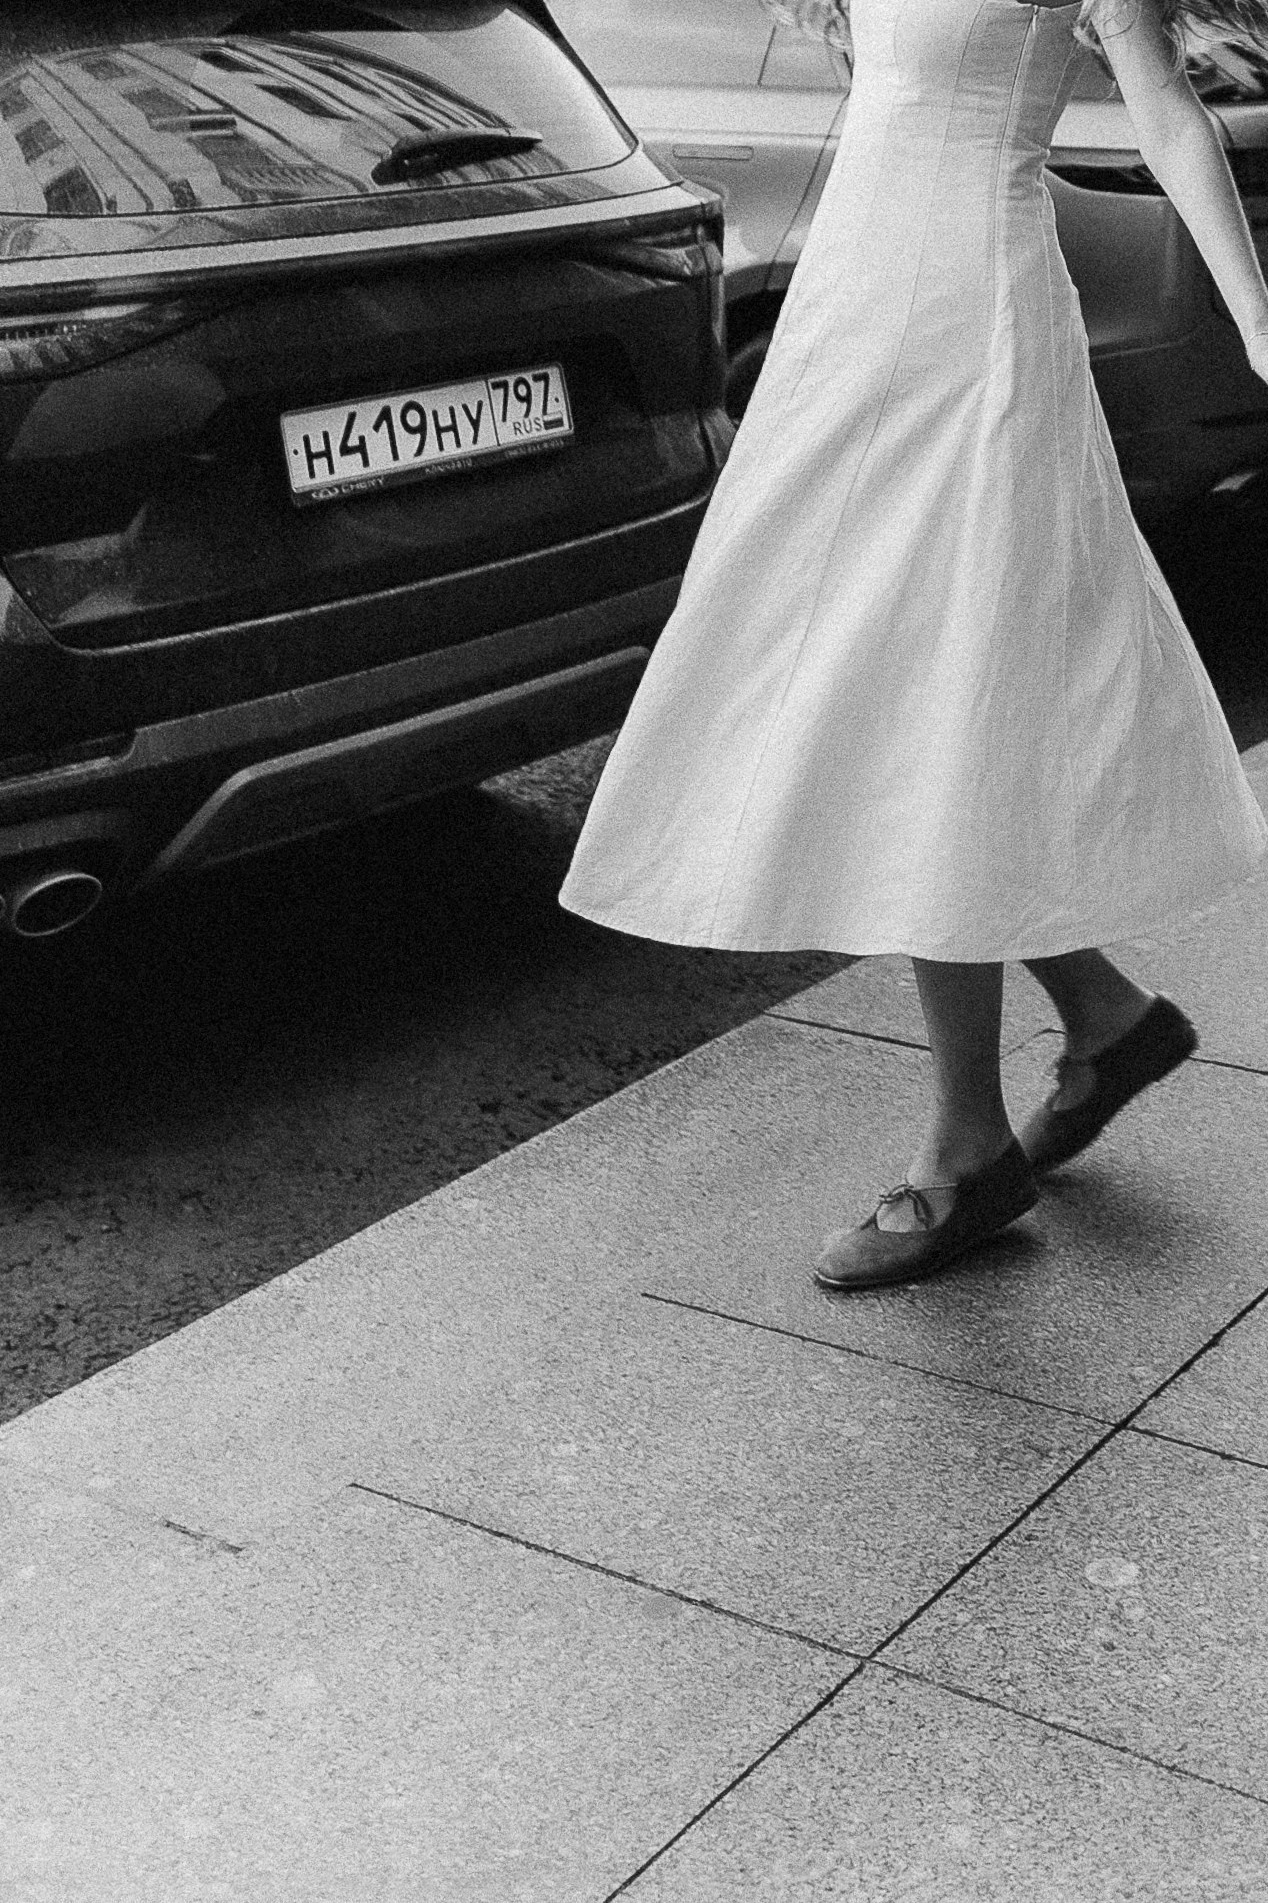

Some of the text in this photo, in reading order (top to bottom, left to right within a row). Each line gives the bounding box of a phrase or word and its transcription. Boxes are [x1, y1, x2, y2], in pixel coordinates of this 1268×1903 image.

[303, 372, 550, 479] Н419НУ 797
[512, 416, 543, 437] RUS
